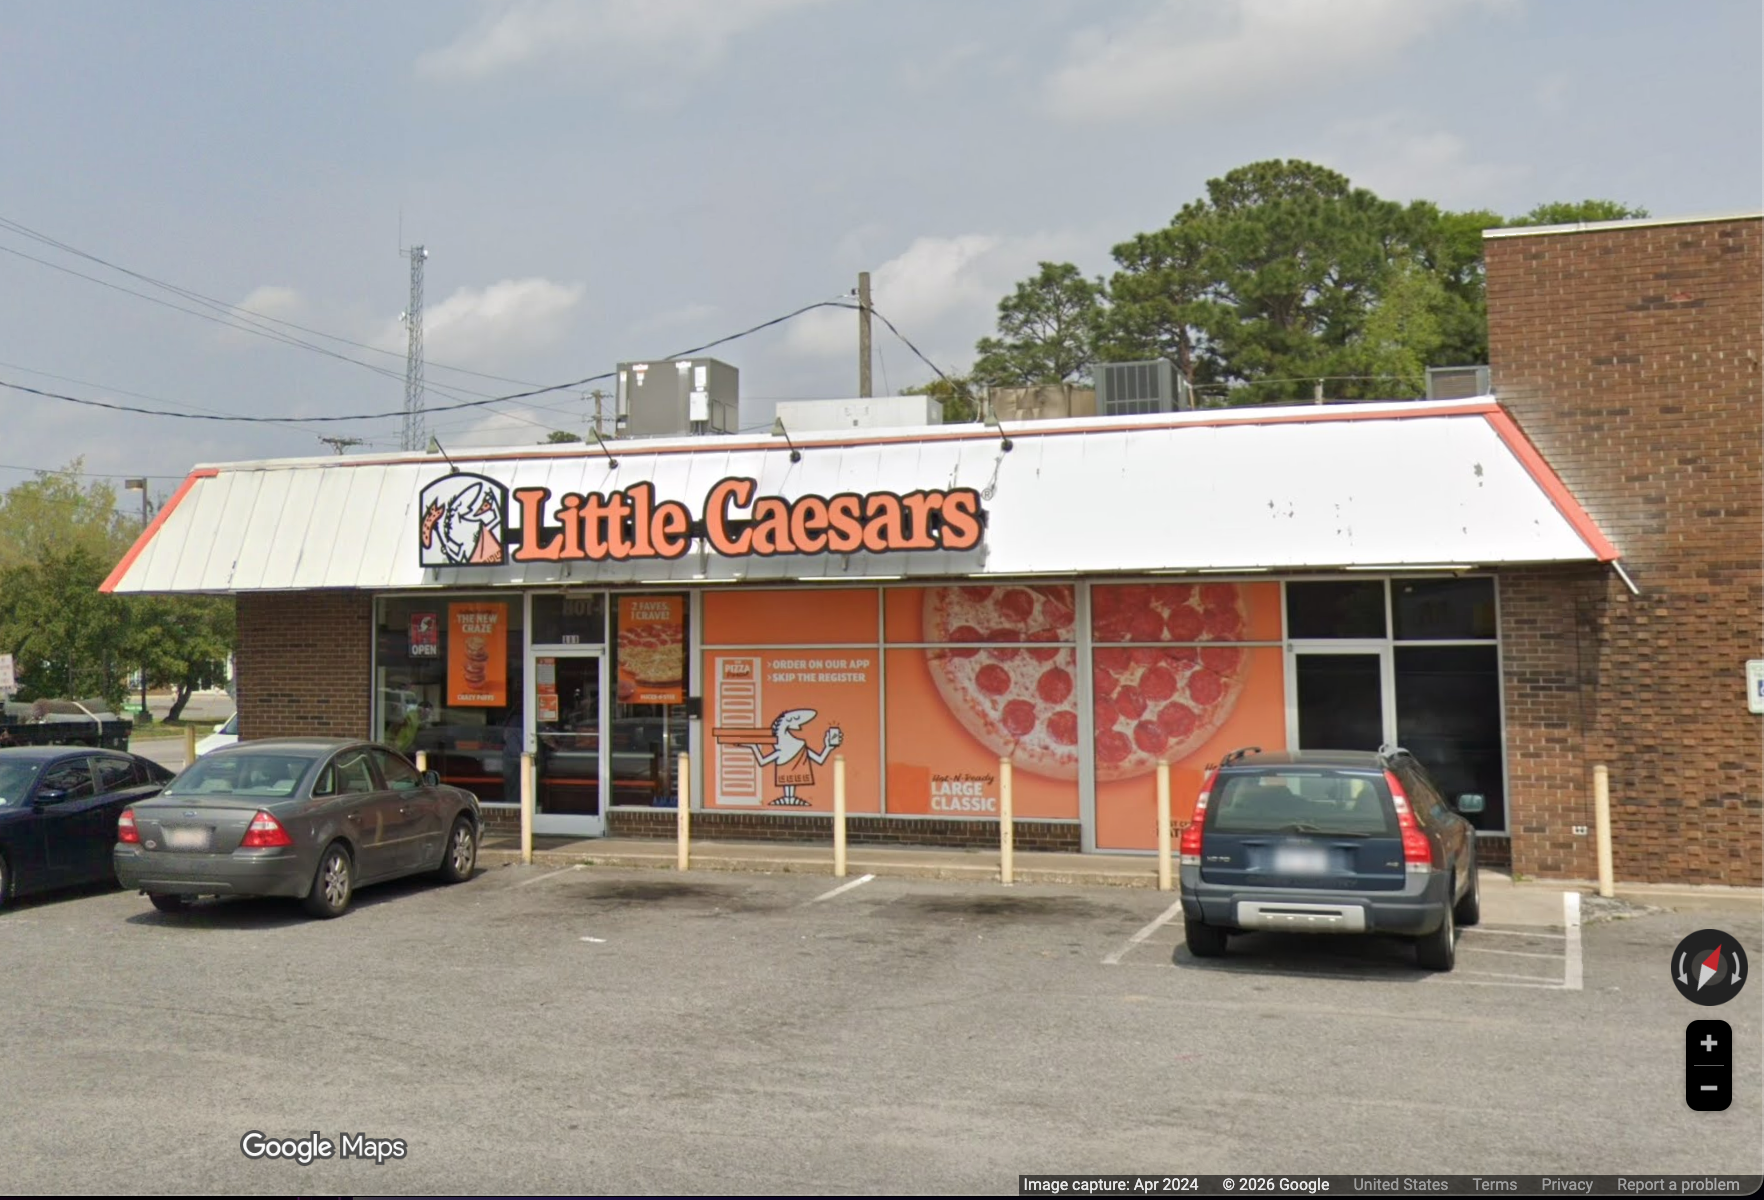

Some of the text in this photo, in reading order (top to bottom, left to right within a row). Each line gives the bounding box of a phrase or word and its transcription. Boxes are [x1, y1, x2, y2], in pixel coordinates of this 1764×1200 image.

[513, 477, 985, 563] Little Caesars
[631, 602, 638, 611] 2
[456, 613, 498, 624] THE NEW
[636, 611, 670, 620] CRAVE!
[462, 623, 493, 633] CRAZE
[411, 644, 437, 655] OPEN
[725, 664, 750, 674] PIZZA
[772, 659, 870, 669] ORDER ON OUR APP
[772, 672, 867, 682] SKIP THE REGISTER
[931, 780, 983, 796] LARGE
[931, 796, 997, 813] CLASSIC
